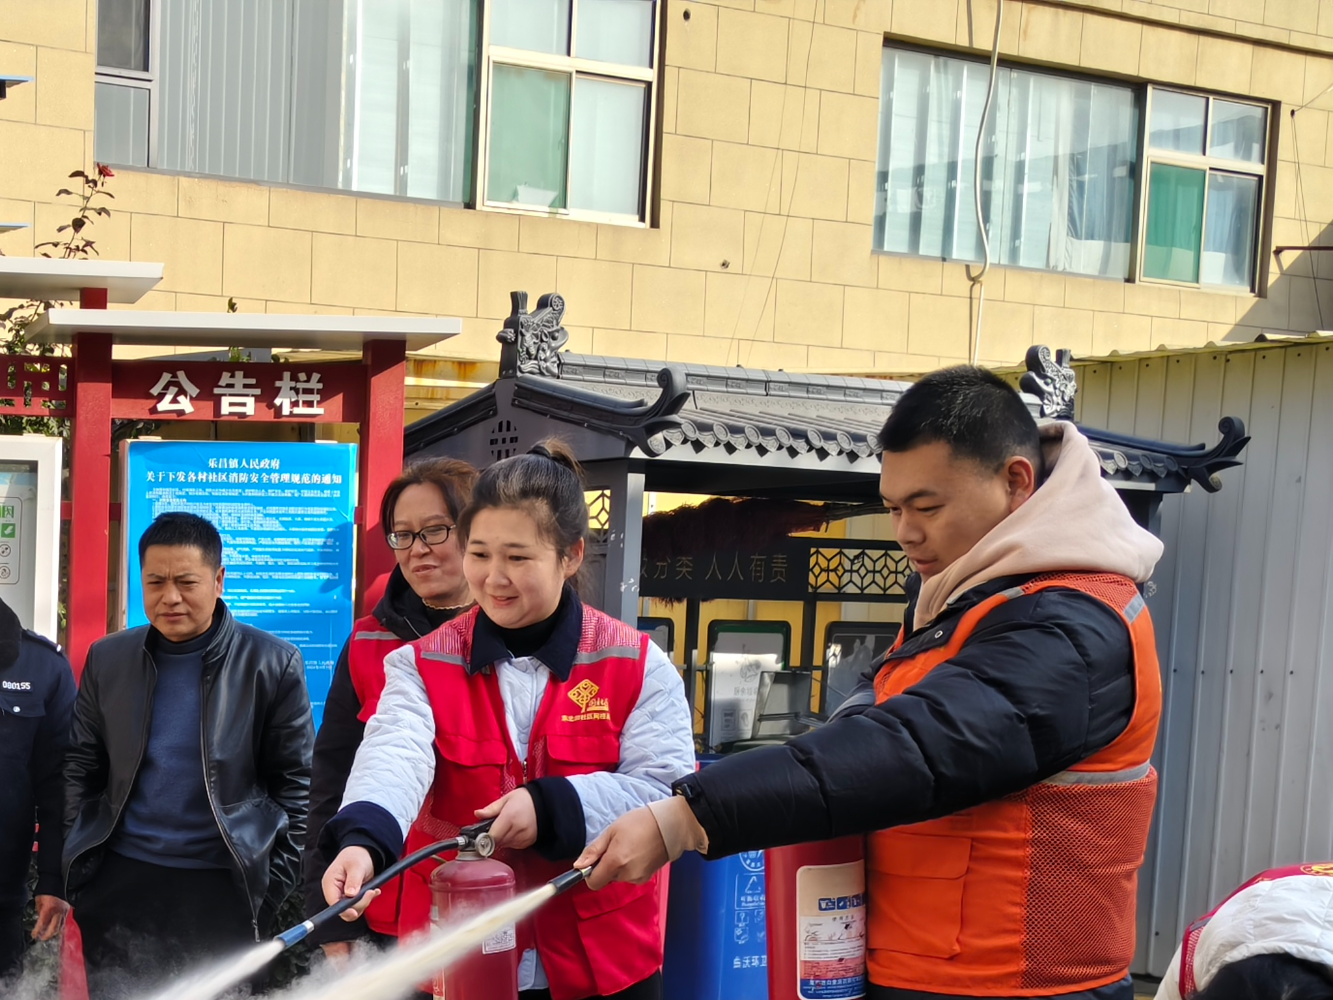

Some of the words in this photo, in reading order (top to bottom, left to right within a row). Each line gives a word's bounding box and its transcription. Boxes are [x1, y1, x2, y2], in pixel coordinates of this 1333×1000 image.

[149, 370, 325, 417] 公告栏
[145, 471, 343, 485] 关于下发各村社区消防安全管理规范的通知
[704, 551, 789, 584] 人人有责
